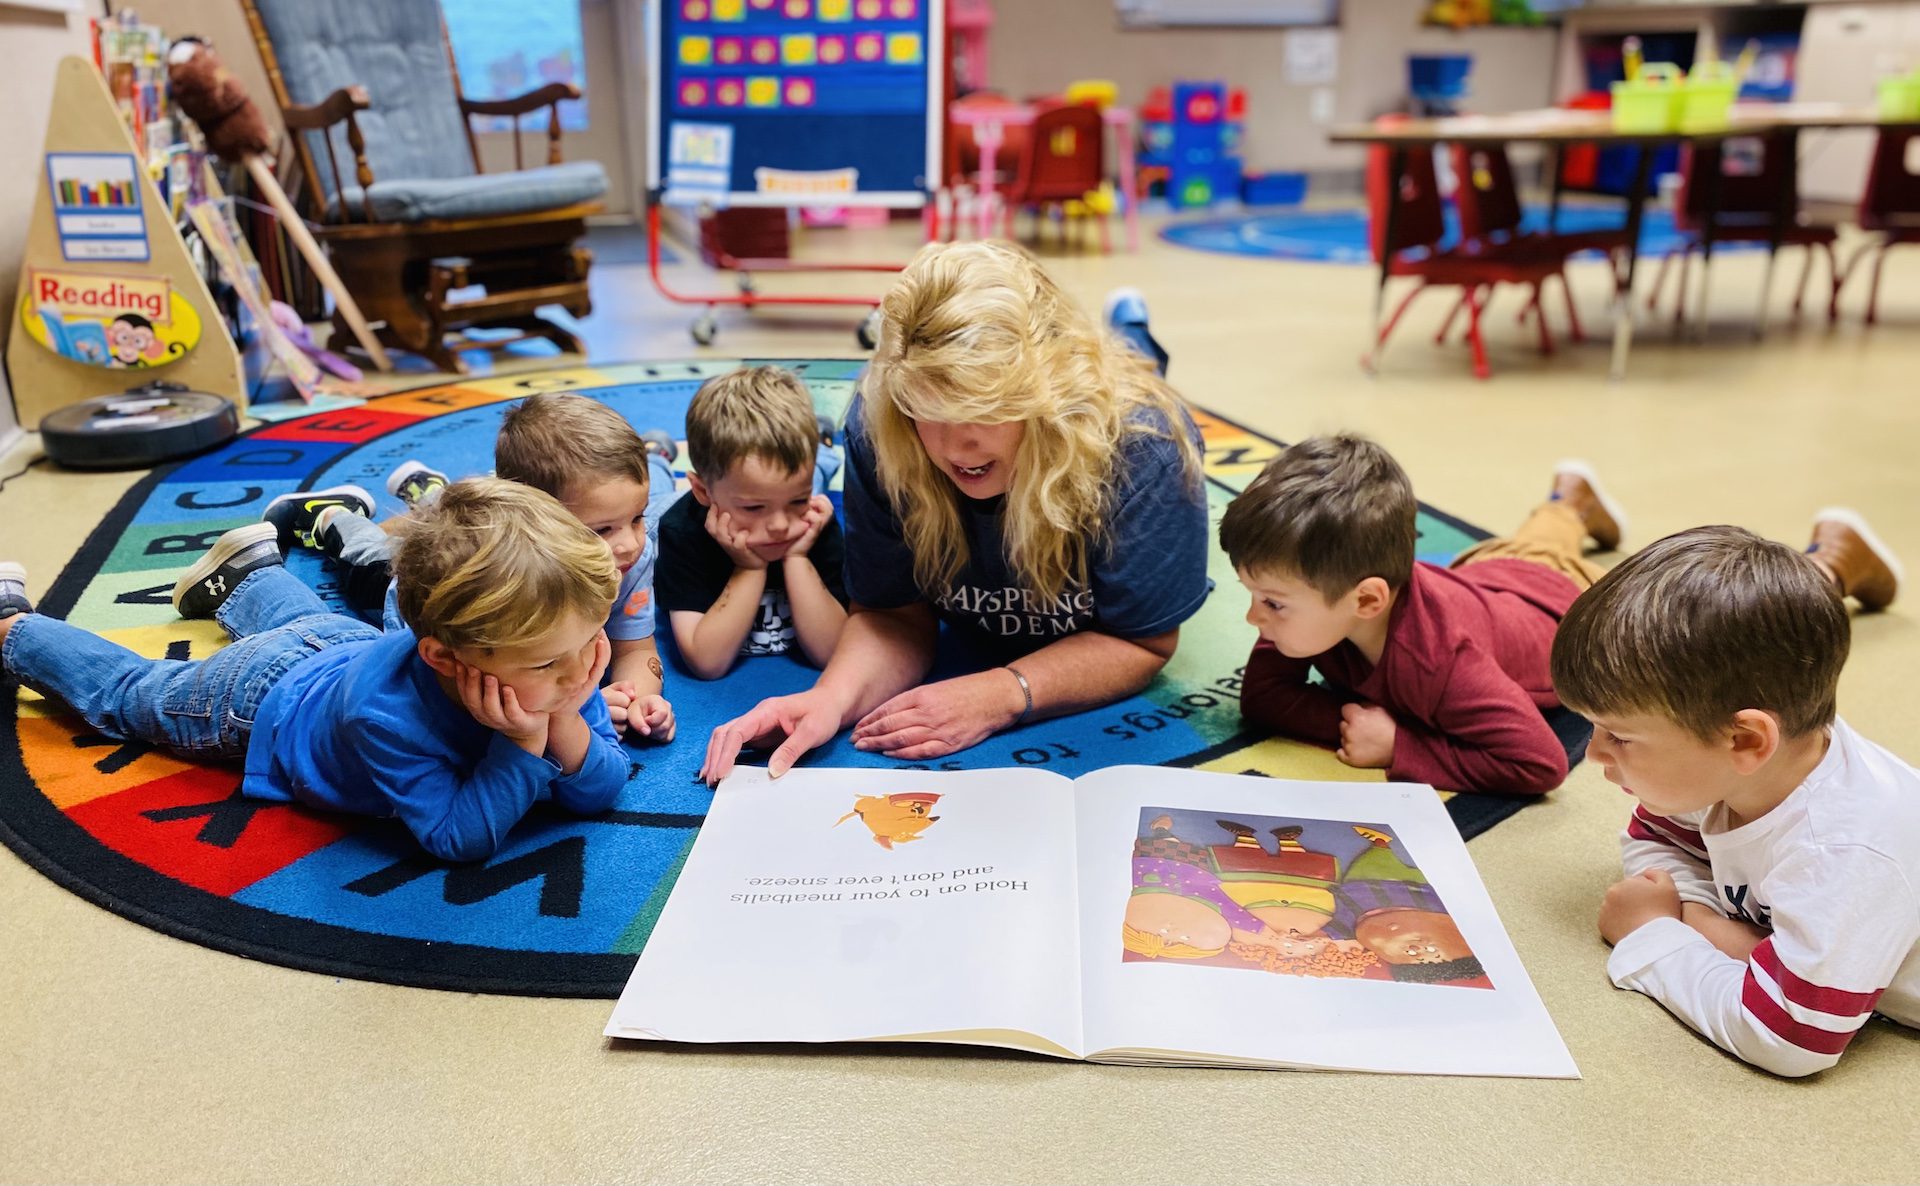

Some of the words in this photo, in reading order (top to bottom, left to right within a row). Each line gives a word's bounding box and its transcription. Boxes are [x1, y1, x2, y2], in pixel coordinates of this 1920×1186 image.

[40, 278, 162, 317] Reading
[300, 419, 378, 432] E
[224, 448, 304, 466] D
[176, 486, 263, 510] C
[143, 529, 231, 556] B
[1011, 743, 1081, 765] to
[891, 871, 945, 885] don't
[953, 865, 994, 880] and
[744, 877, 828, 886] sneeze.
[834, 876, 883, 885] ever
[975, 880, 1029, 892] Hold
[849, 889, 901, 901] your
[910, 888, 929, 898] to
[939, 884, 967, 895] on
[730, 892, 842, 904] meatballs
